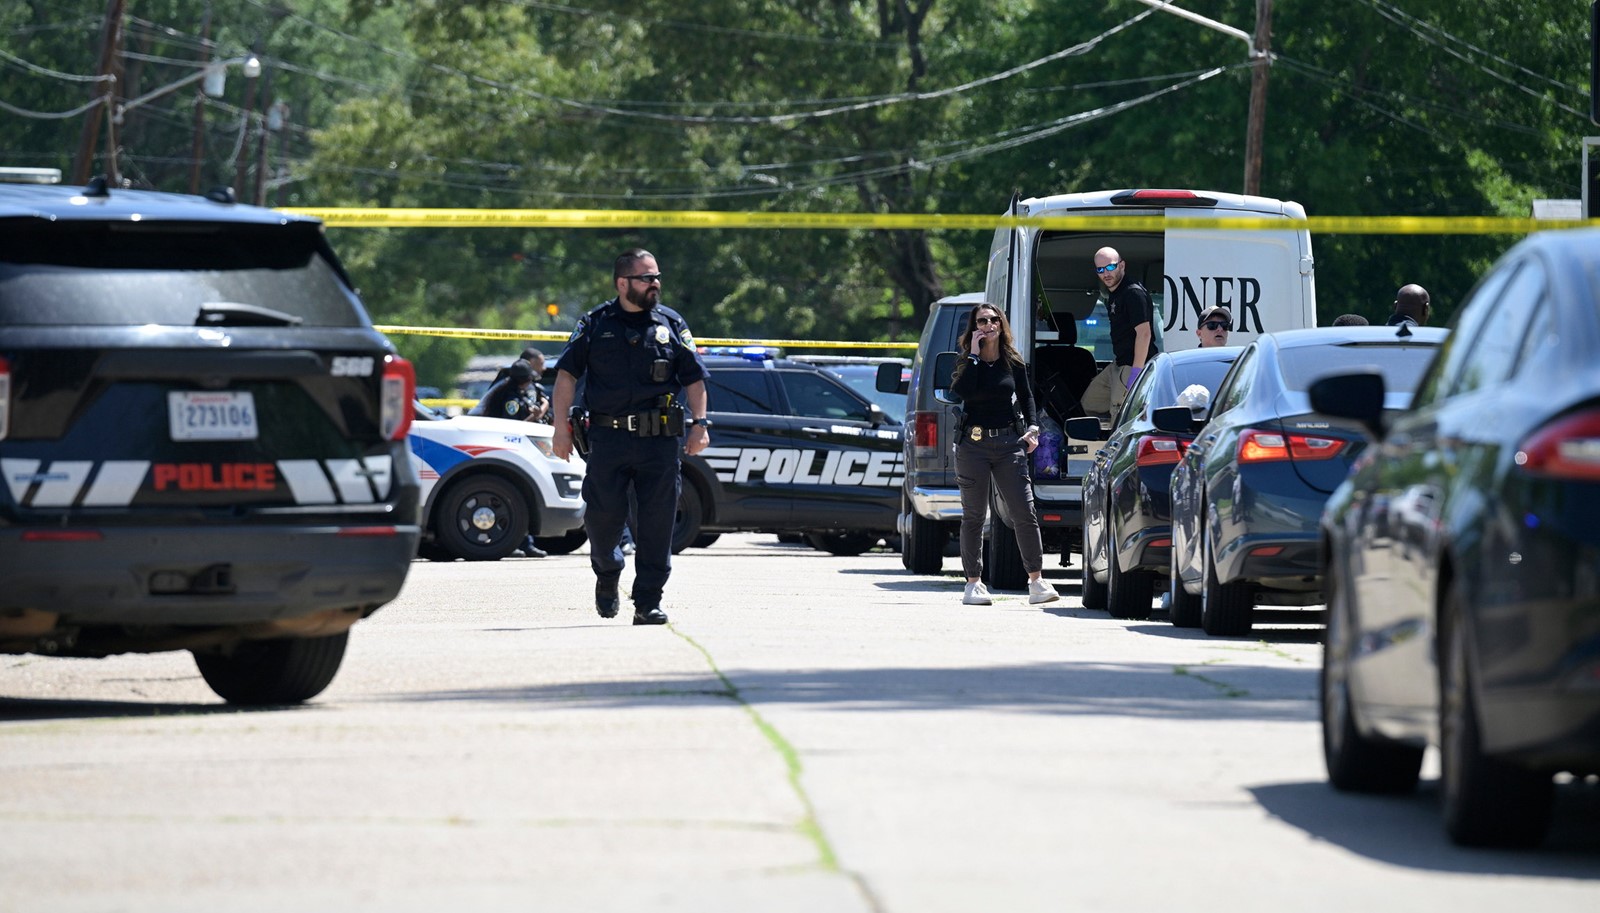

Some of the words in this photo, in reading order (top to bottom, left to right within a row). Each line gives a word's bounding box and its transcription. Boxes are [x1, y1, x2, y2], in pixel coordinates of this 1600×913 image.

[186, 403, 253, 428] 273106
[153, 462, 276, 491] POLICE
[732, 449, 897, 486] POLICE
